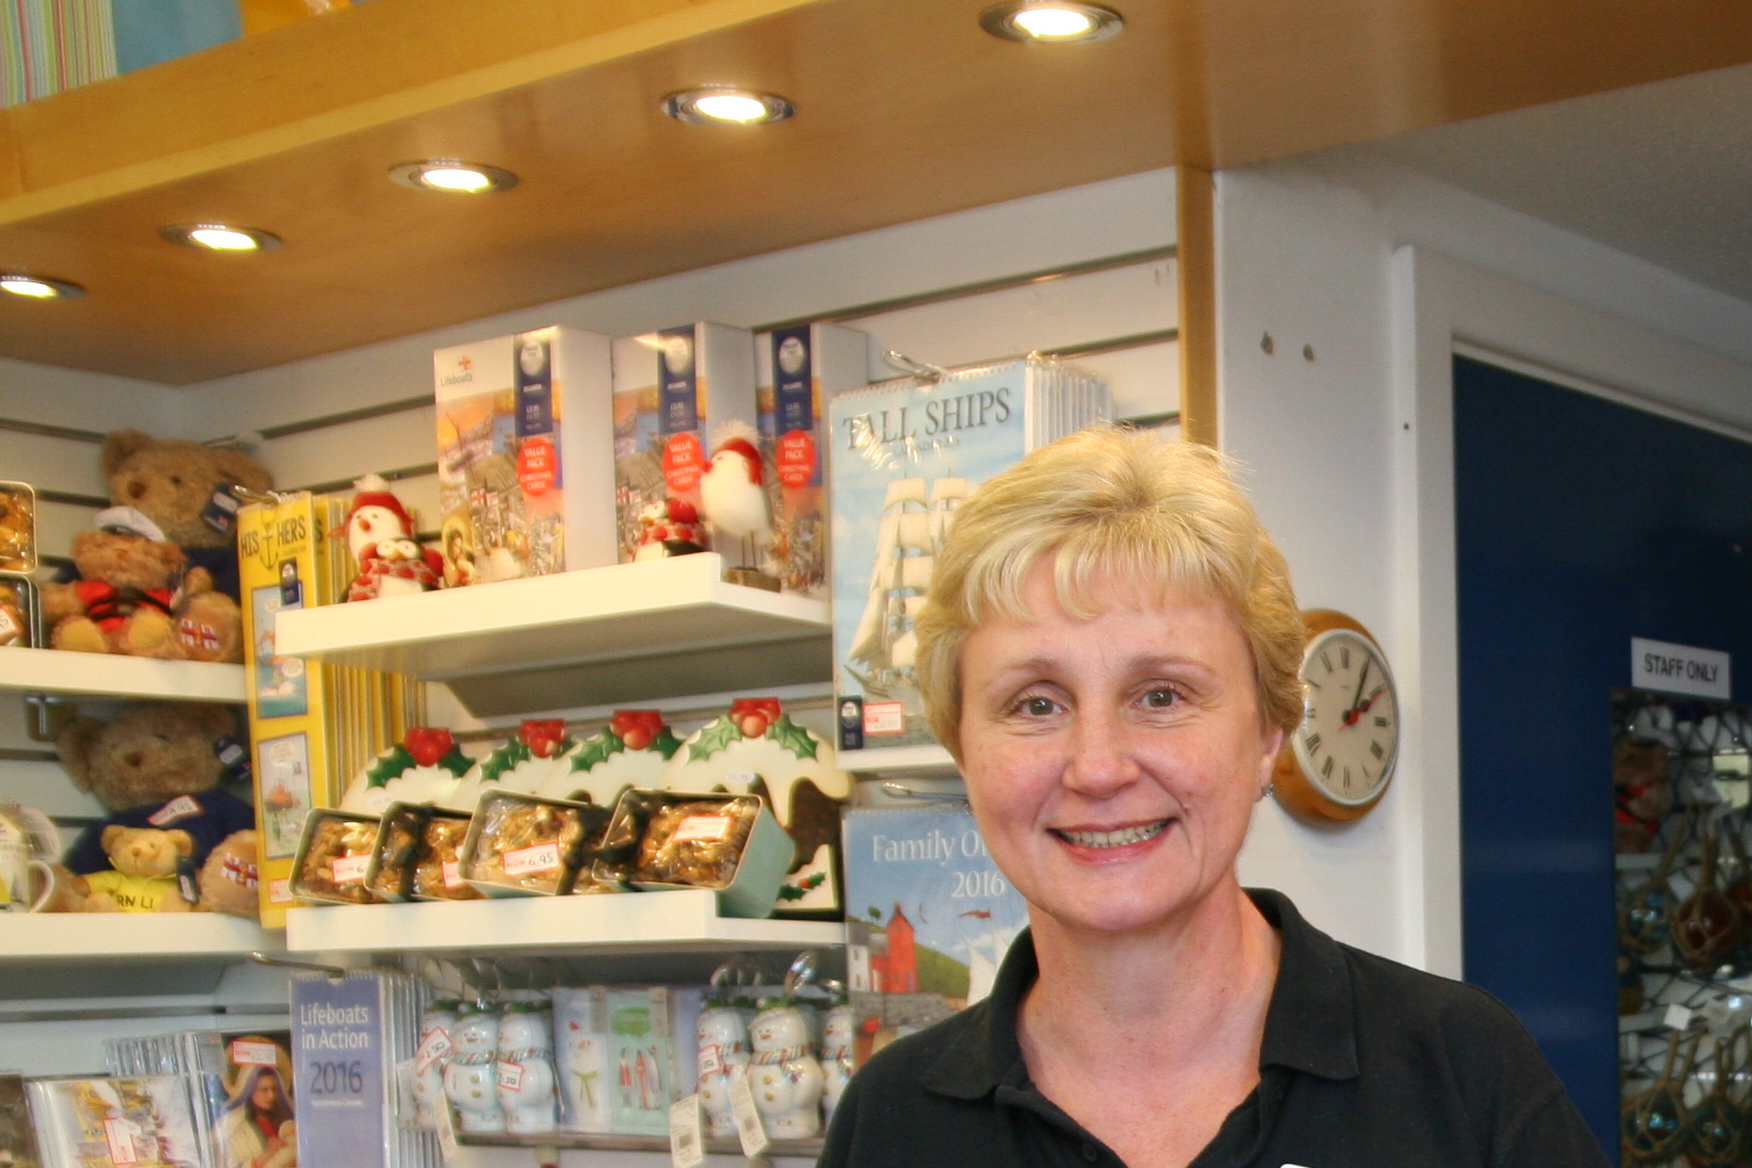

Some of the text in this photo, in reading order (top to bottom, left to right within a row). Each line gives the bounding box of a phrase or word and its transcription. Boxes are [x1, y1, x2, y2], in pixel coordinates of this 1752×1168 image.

[842, 406, 916, 451] TALL
[925, 386, 1011, 436] SHIPS
[523, 445, 547, 459] VALUE
[669, 440, 693, 454] VALUE
[782, 436, 806, 450] VALUE
[784, 447, 804, 460] PACK
[525, 457, 545, 469] PACK
[671, 452, 691, 464] PACK
[239, 515, 307, 559] HIS HERS
[1644, 652, 1719, 683] STAFF ONLY
[872, 828, 956, 867] Family
[952, 870, 1006, 898] 2016
[300, 1001, 369, 1026] Lifeboats
[301, 1028, 369, 1050] in Action
[308, 1059, 364, 1095] 2016
